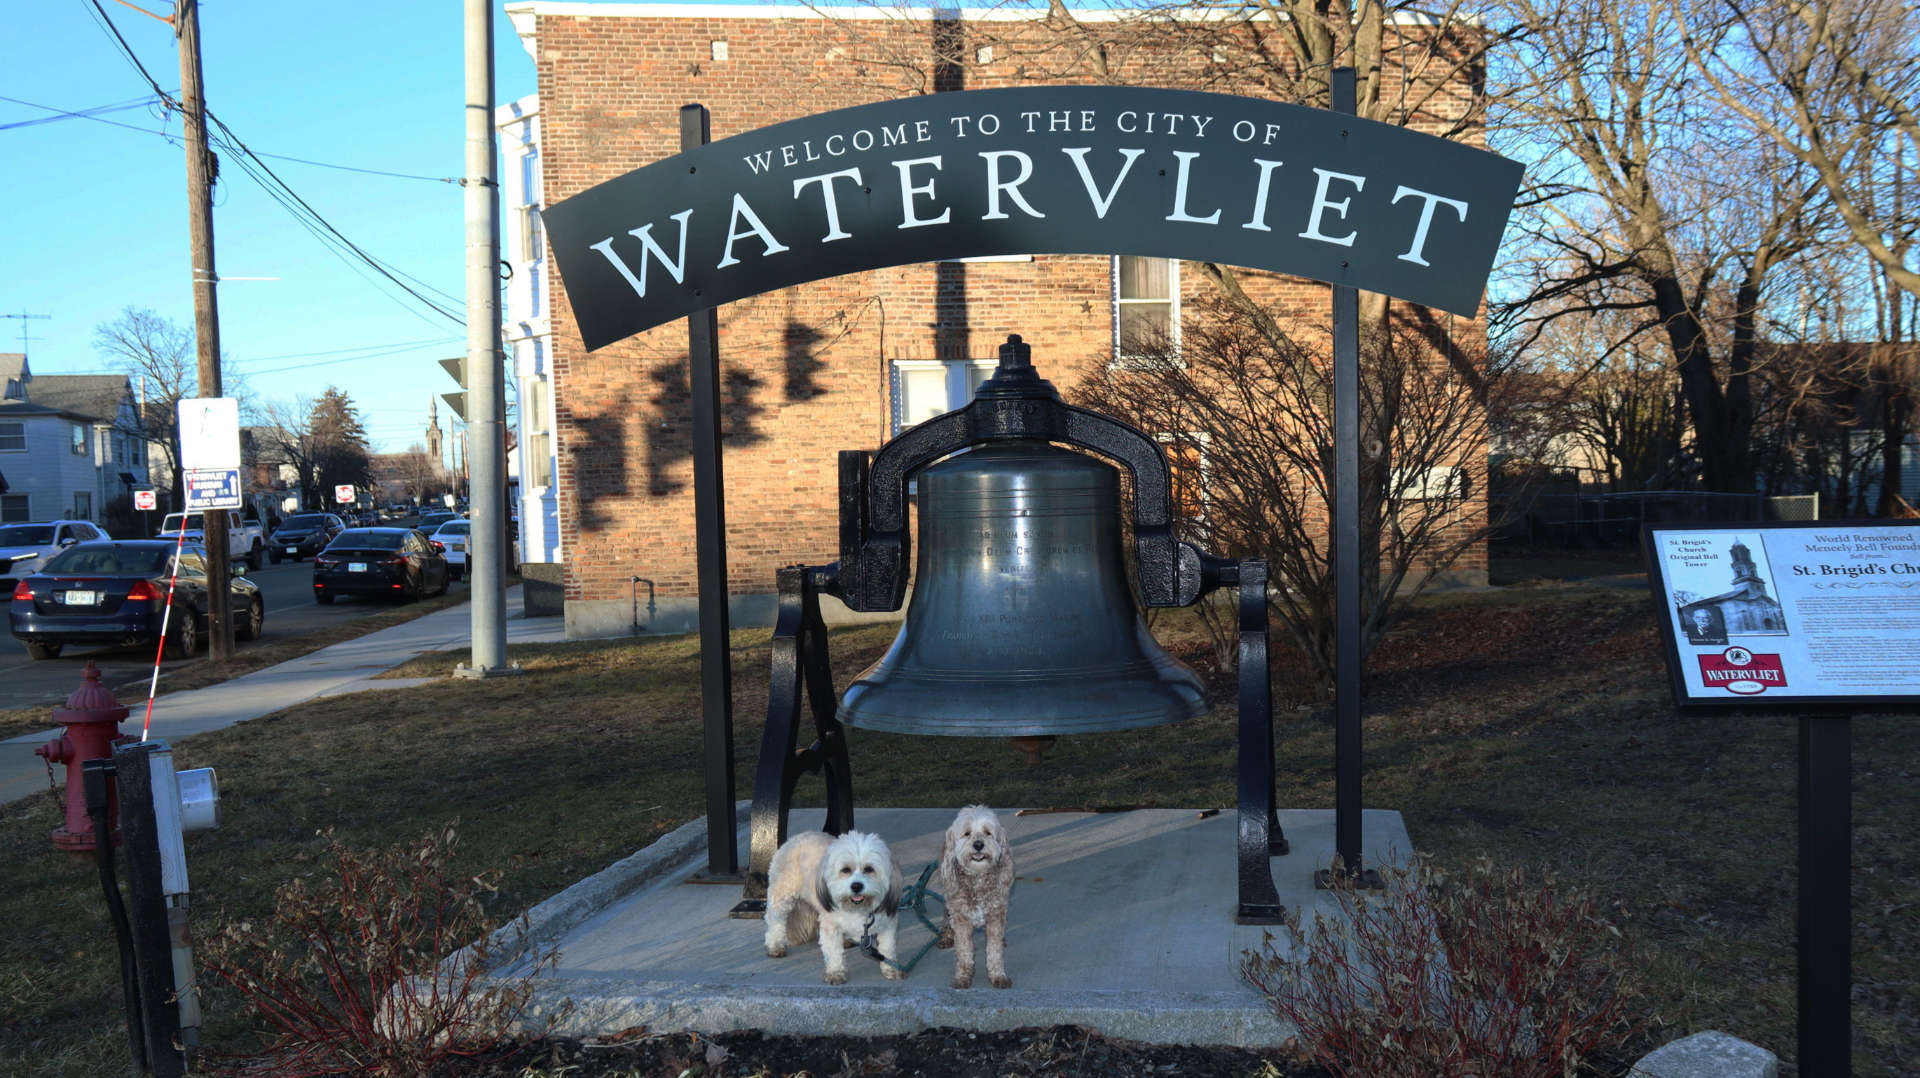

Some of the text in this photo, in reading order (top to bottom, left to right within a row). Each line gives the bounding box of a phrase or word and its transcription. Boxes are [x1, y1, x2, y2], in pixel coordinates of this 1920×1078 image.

[743, 110, 1281, 175] WELCOME TO THE CITY OF
[589, 144, 1469, 298] WATERVLIET
[1815, 533, 1913, 543] World Renowned
[1855, 542, 1878, 552] Bell
[1792, 564, 1816, 576] St.
[1819, 563, 1887, 578] Brigid's
[1705, 669, 1780, 681] WATERVLIET
